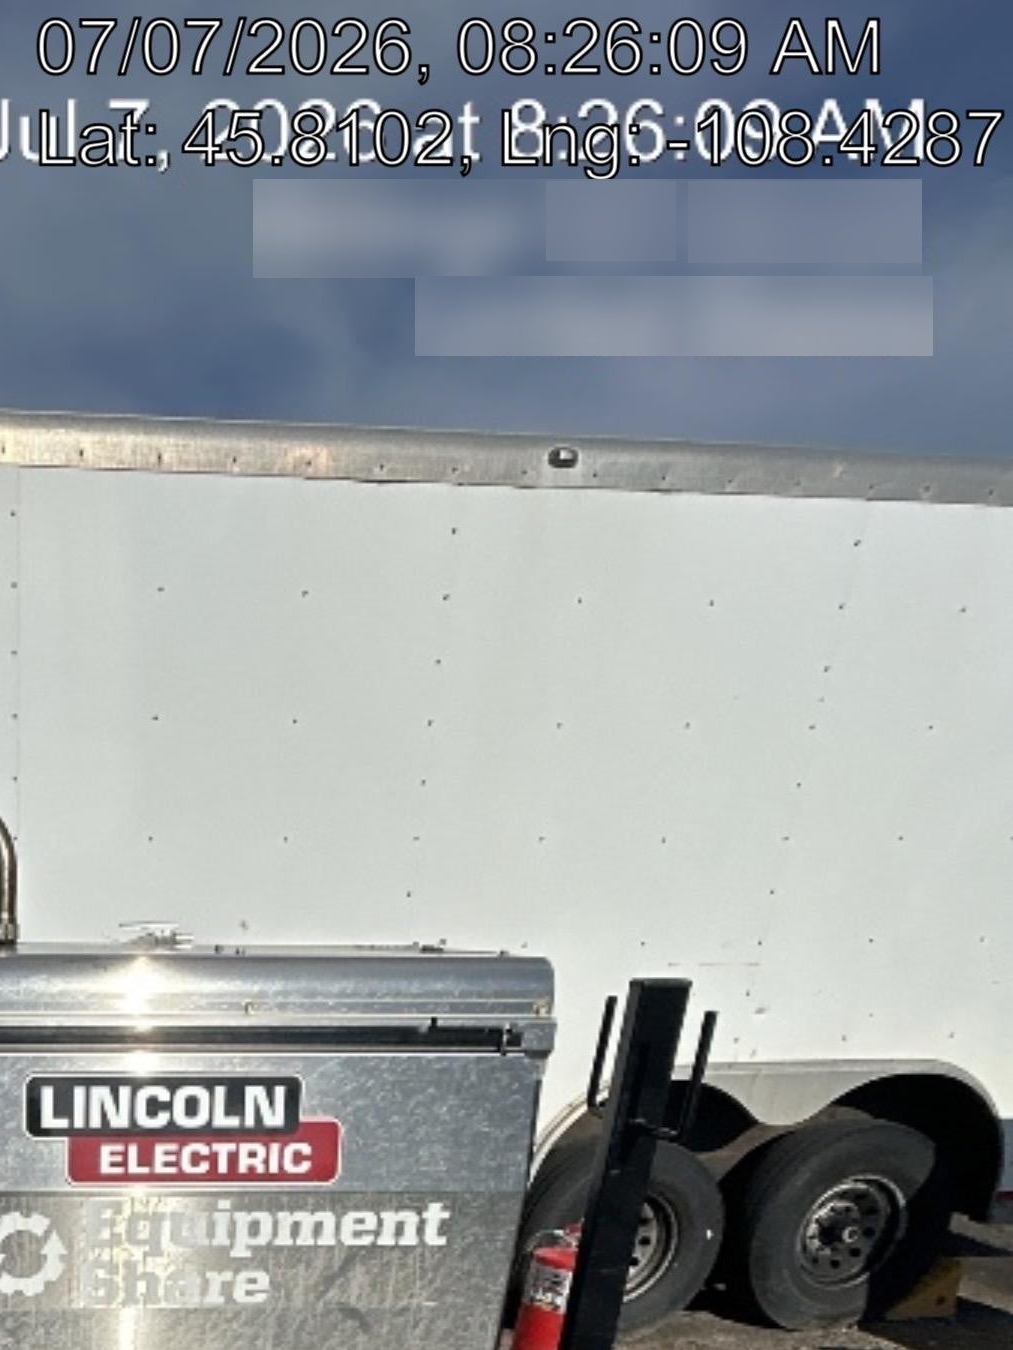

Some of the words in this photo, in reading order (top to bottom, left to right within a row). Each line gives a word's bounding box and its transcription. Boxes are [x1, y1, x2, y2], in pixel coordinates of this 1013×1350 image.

[40, 1085, 287, 1129] LINCOLN
[99, 1142, 313, 1175] ELECTRIC
[86, 1199, 450, 1257] Equipment
[82, 1258, 270, 1304] Share
